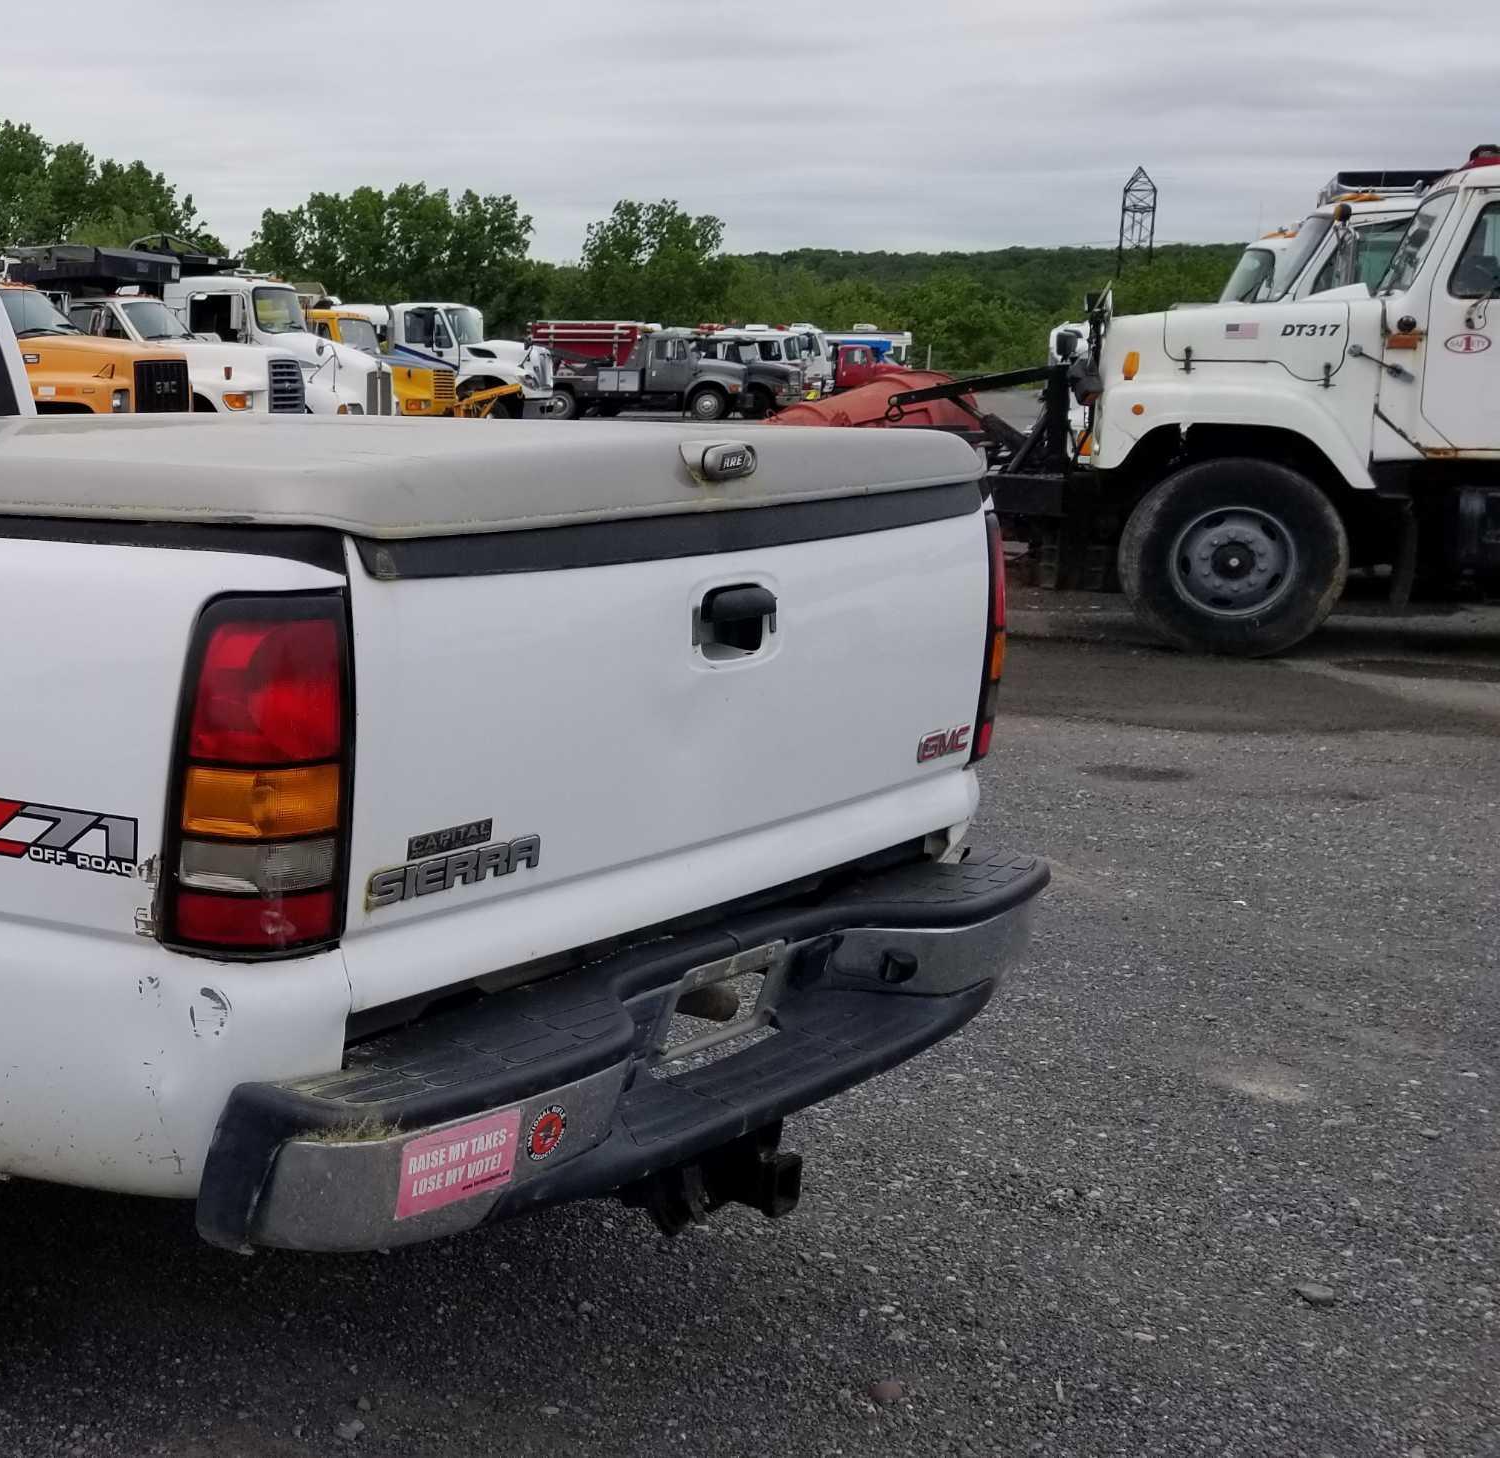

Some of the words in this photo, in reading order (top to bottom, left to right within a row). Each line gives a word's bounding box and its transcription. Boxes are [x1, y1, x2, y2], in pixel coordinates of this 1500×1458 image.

[1280, 323, 1341, 338] DT317
[917, 723, 971, 763] GMC
[411, 822, 491, 851] CAPITAL
[29, 846, 68, 864] OFF
[76, 854, 138, 878] ROAD
[367, 834, 541, 909] SIERRA
[407, 1148, 447, 1176] RAISE
[447, 1140, 470, 1162] MY
[470, 1127, 508, 1156] TAXES
[411, 1171, 445, 1198] LOSE
[444, 1164, 468, 1188] MY
[466, 1152, 503, 1180] VOTE!
